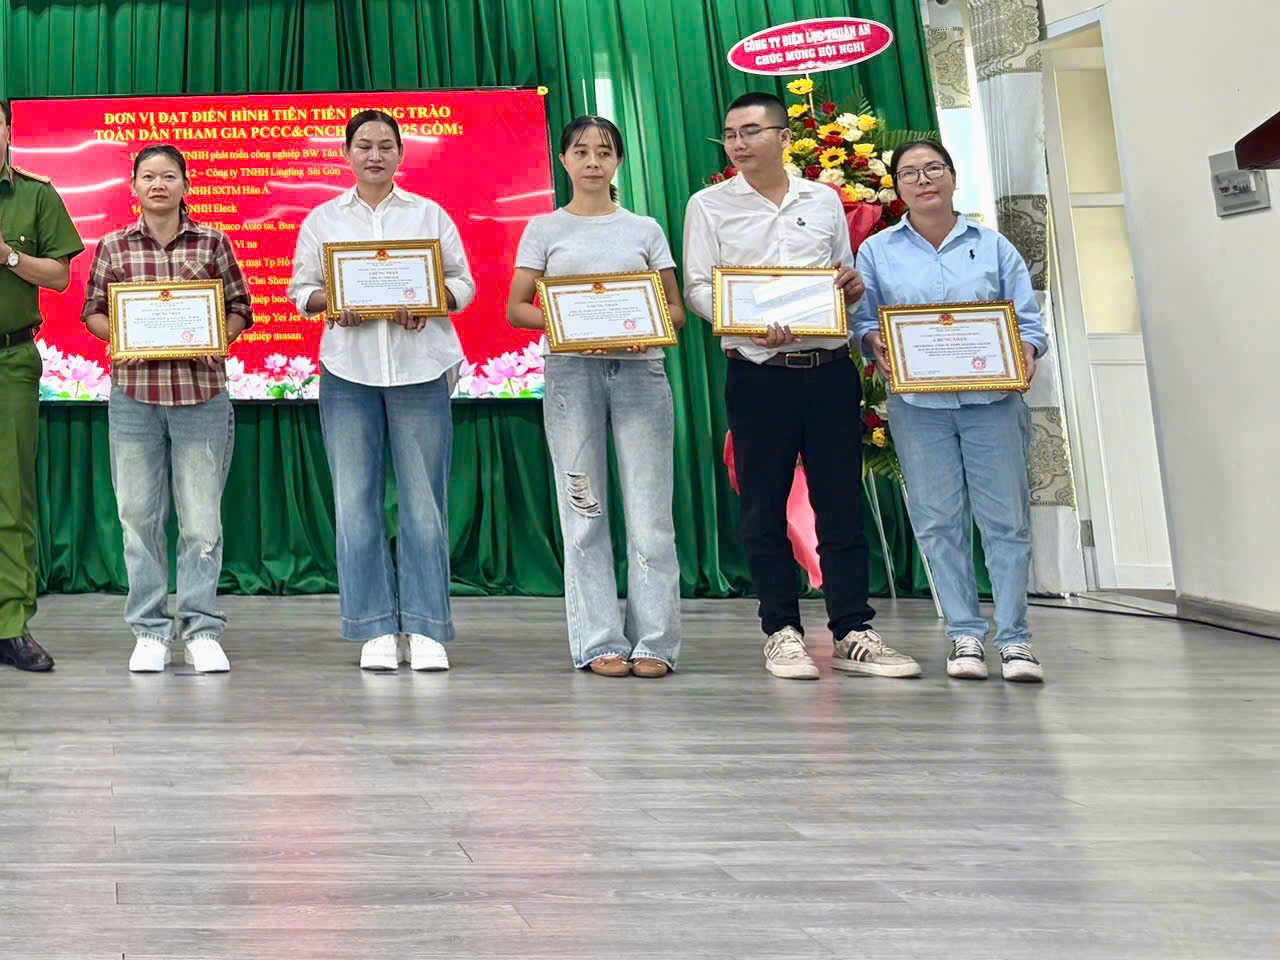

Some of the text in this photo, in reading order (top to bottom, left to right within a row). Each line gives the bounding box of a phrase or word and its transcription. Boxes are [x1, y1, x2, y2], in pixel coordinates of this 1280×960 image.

[158, 111, 188, 126] ĐẠT
[231, 107, 269, 122] HÌNH
[173, 128, 217, 140] THAM
[221, 128, 248, 140] GIA
